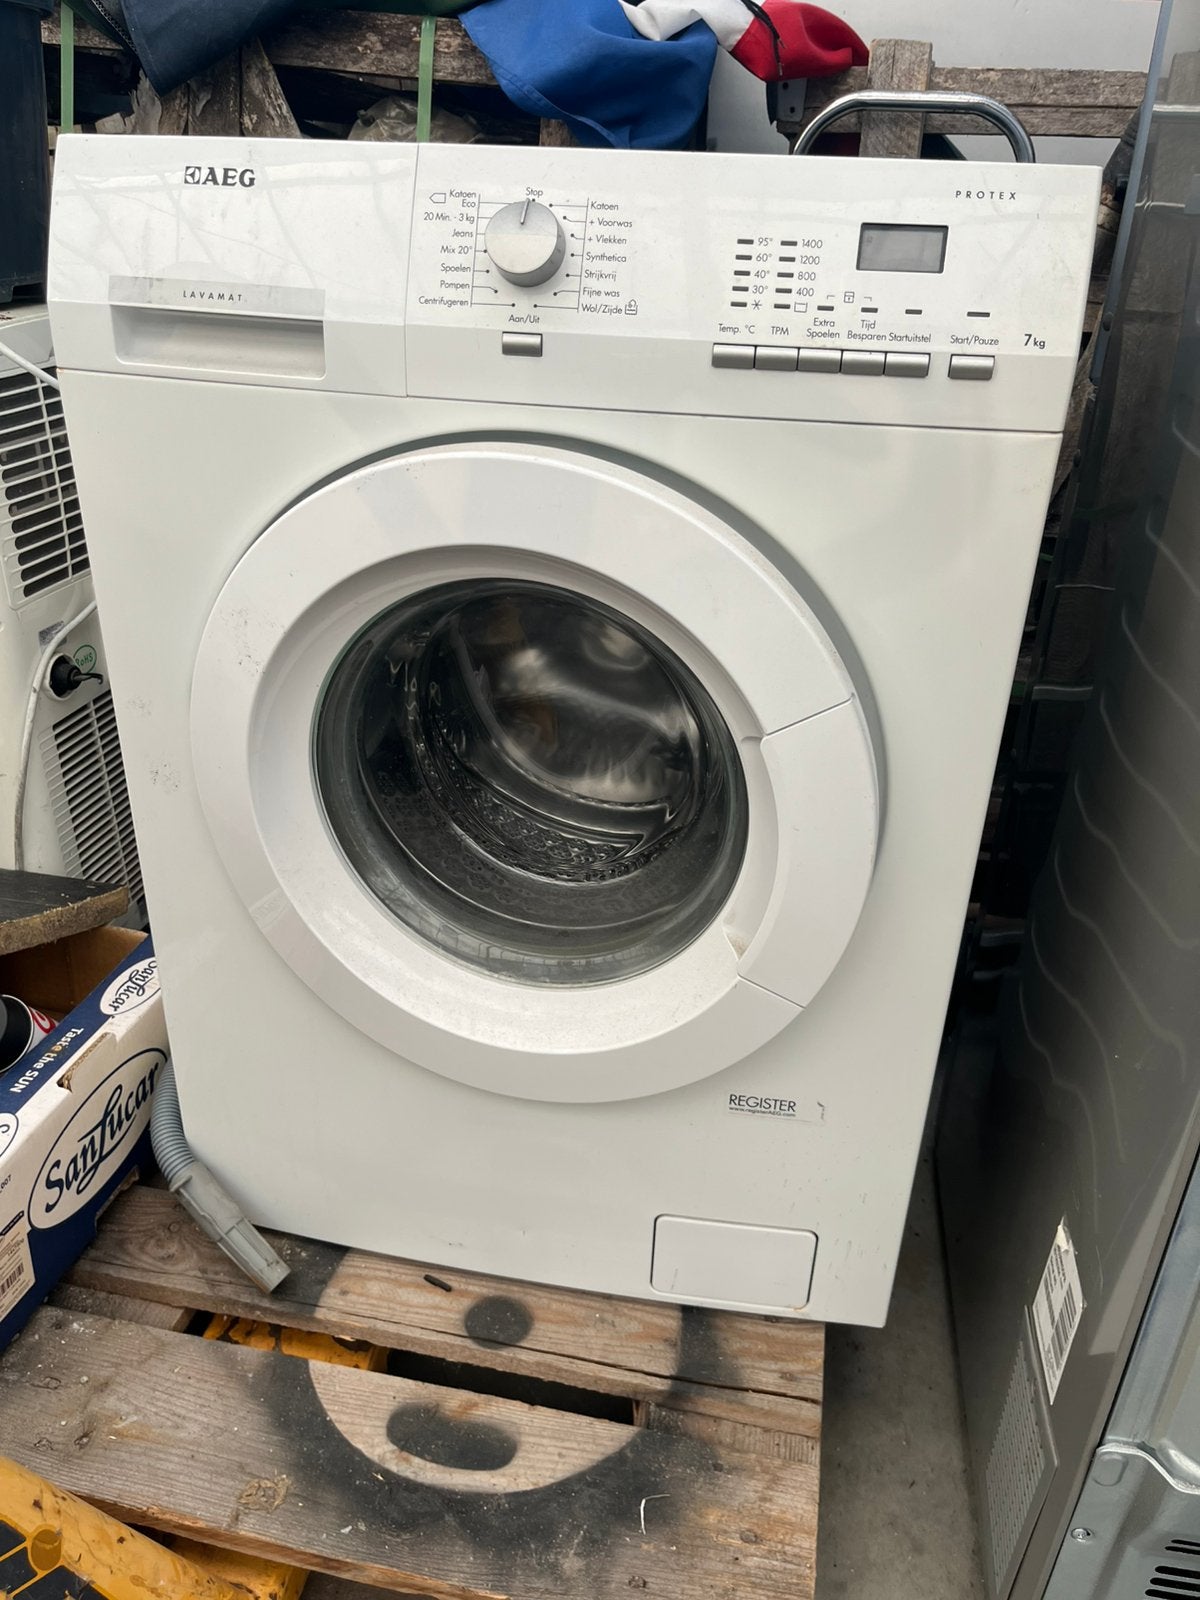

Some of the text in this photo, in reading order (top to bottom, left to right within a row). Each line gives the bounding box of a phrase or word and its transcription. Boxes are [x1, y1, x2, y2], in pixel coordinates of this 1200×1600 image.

[202, 167, 256, 188] AEG
[449, 189, 477, 199] Katoen
[525, 187, 544, 198] Stop
[955, 190, 1017, 200] PROTEX
[461, 200, 476, 208] Eco
[590, 202, 619, 211] Katoen
[423, 213, 433, 221] 20
[434, 213, 452, 222] Min.
[459, 214, 465, 222] 3
[466, 214, 475, 225] kg
[597, 219, 633, 228] Voorwas
[452, 229, 474, 238] Jeans
[595, 235, 627, 245] Vlekken
[801, 238, 823, 249] 1400
[440, 245, 456, 254] Mix
[585, 252, 627, 263] Synthetica
[799, 254, 821, 265] 1200
[440, 263, 472, 274] Spoelen
[584, 270, 617, 281] Strijkvrij
[797, 271, 816, 281] 800
[440, 281, 470, 291] Pompen
[183, 290, 243, 302] LAVAMAT
[583, 287, 620, 298] Fijne was
[796, 287, 815, 297] 400
[418, 296, 469, 308] Centrifugeren
[581, 304, 623, 316] Wol/Zijde
[508, 315, 540, 324] Aan/Uit
[813, 318, 835, 328] Extra
[860, 319, 876, 331] Tijd
[718, 323, 742, 335] Temp.
[771, 326, 789, 336] TPM
[806, 328, 840, 340] Spoelen
[847, 330, 887, 342] Besparen
[888, 332, 932, 343] Startuitstel
[950, 335, 999, 346] Start/Pauze
[10, 1027, 84, 1093] Taste the SUN
[729, 1094, 796, 1112] REGISTER
